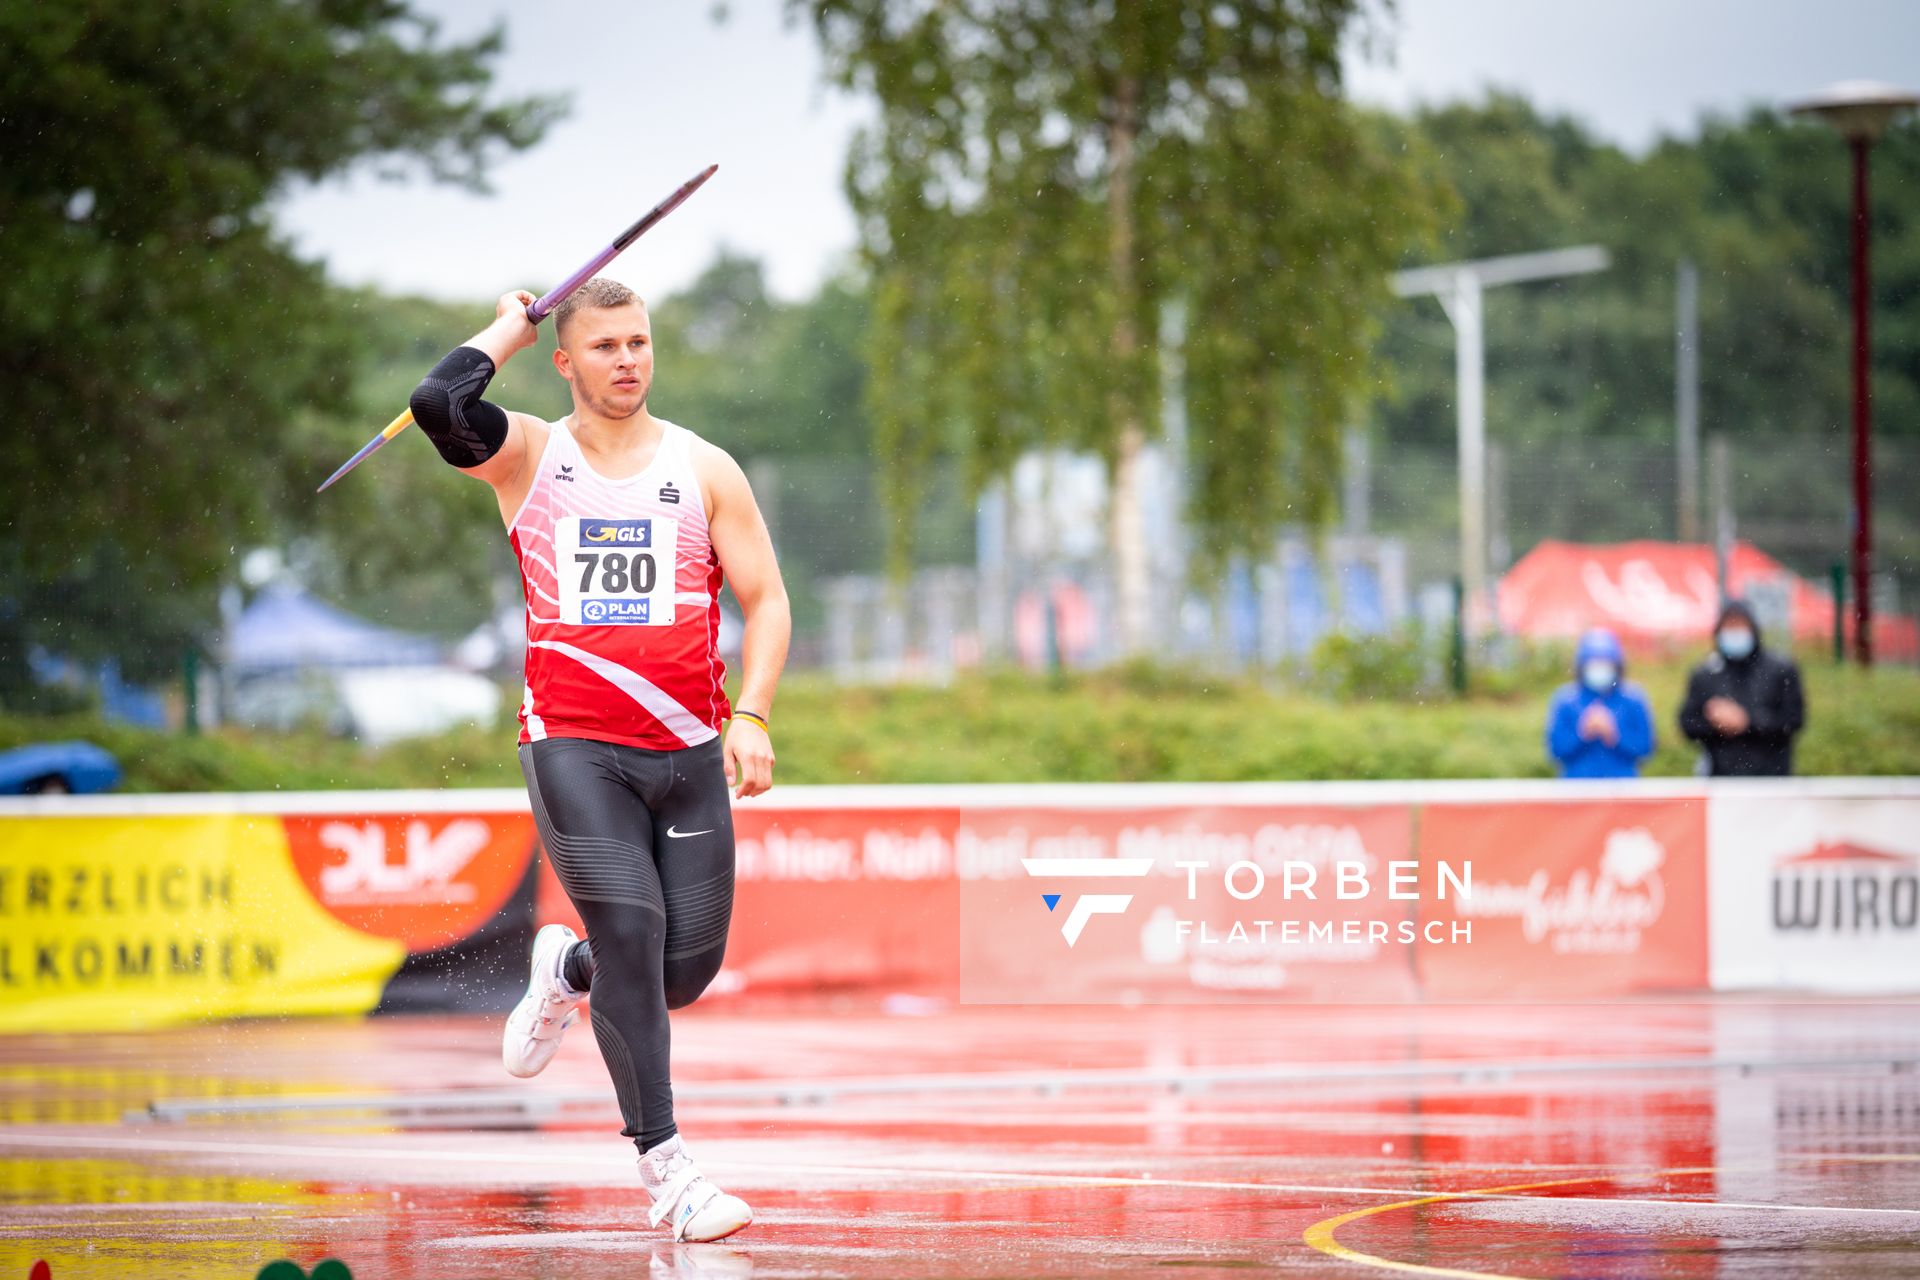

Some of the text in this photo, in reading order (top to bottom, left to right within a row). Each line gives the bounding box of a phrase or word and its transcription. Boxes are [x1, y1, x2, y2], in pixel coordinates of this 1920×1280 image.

[555, 474, 575, 482] erima
[617, 527, 646, 542] GLS
[574, 552, 657, 594] 780
[608, 602, 648, 615] PLAN
[1772, 874, 1919, 932] WIRO
